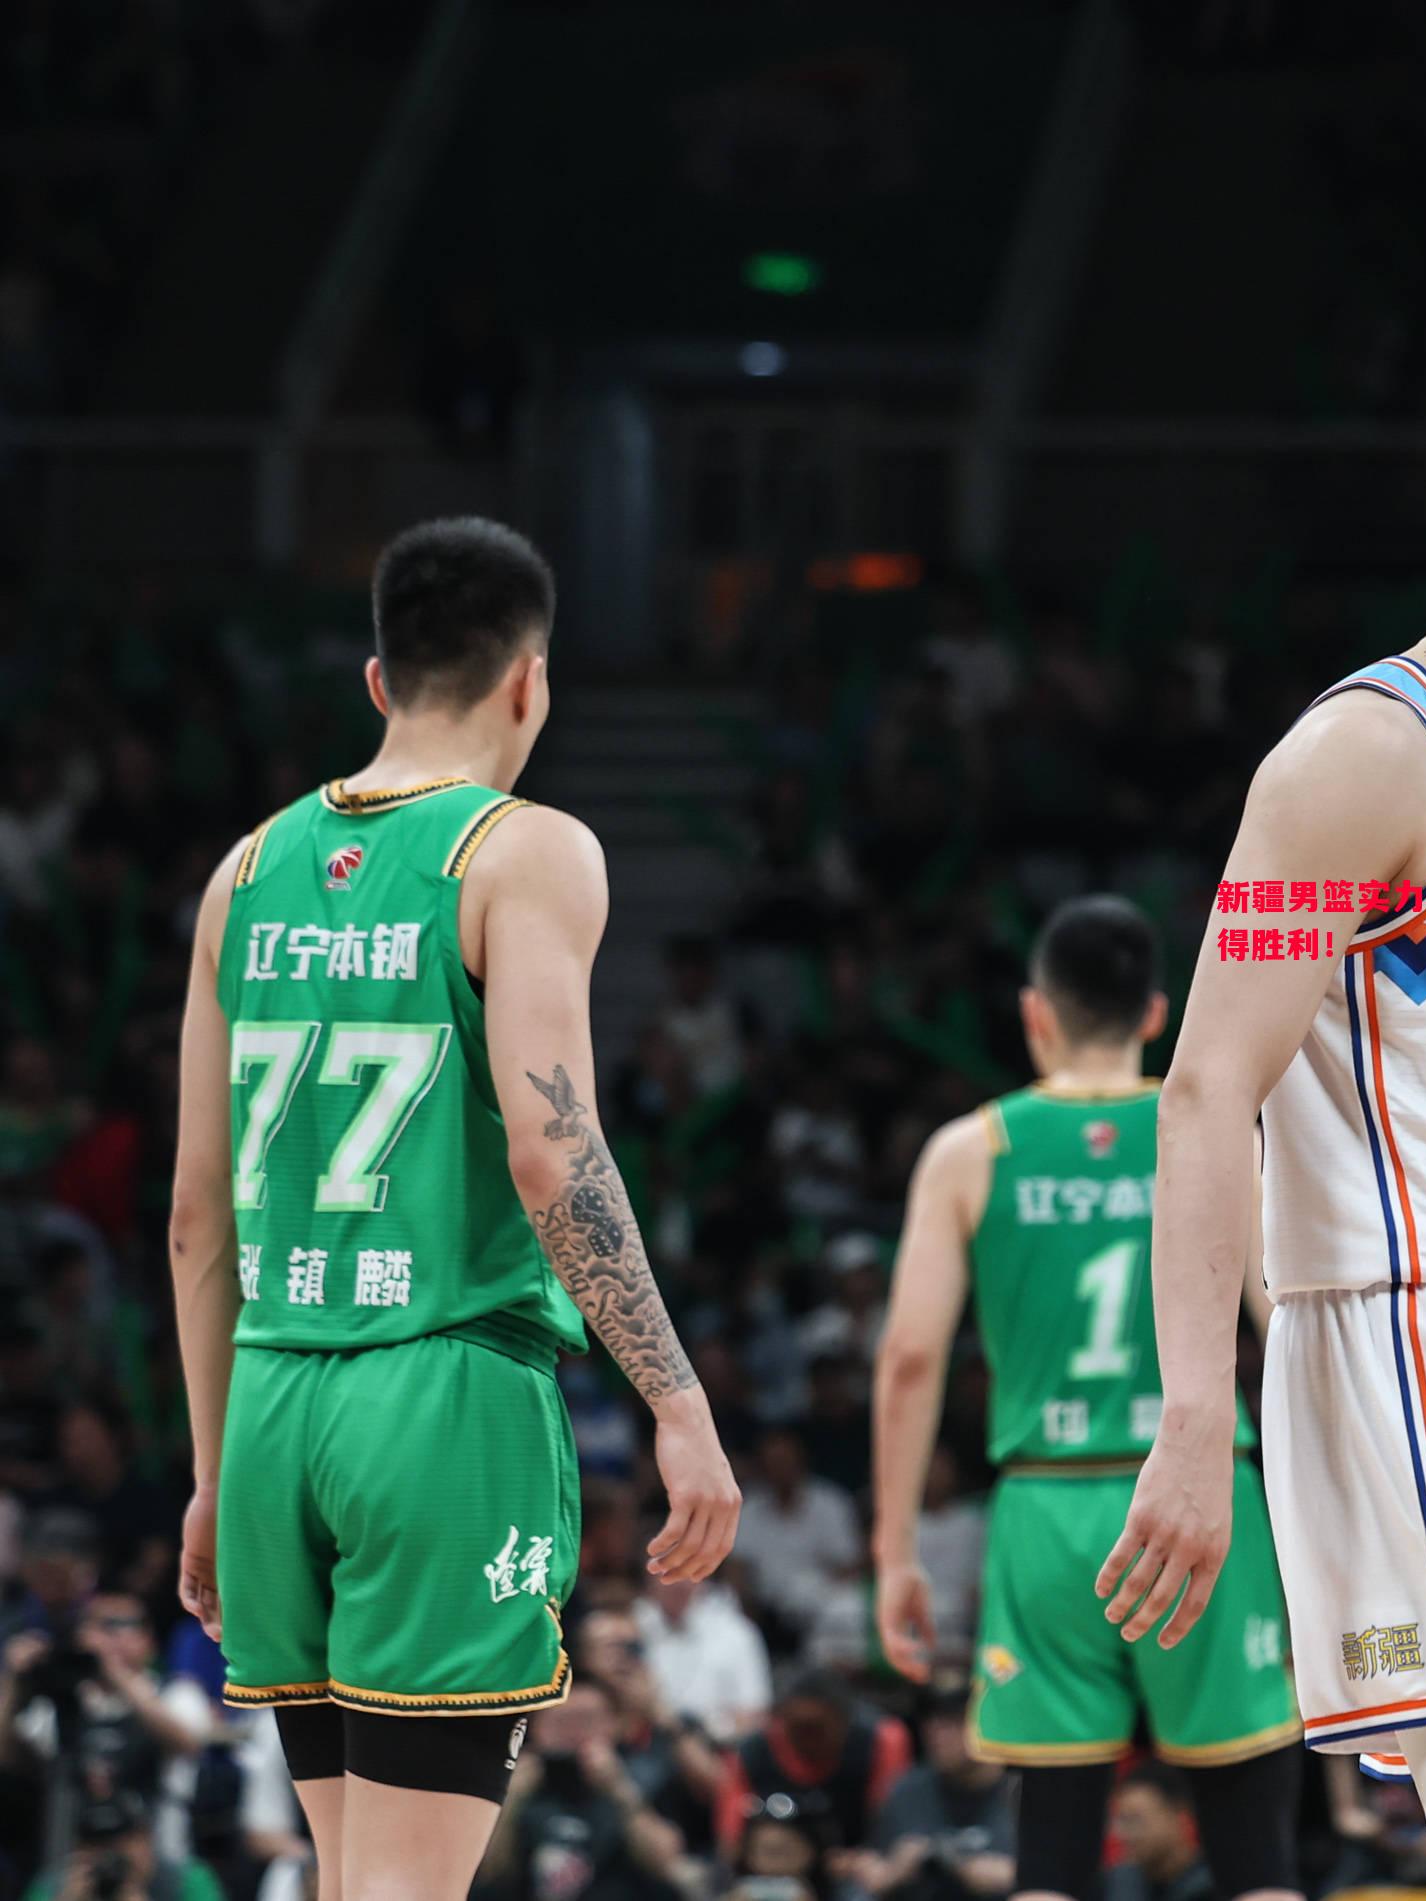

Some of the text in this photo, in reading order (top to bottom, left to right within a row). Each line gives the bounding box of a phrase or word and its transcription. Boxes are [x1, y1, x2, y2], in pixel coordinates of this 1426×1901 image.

[244, 922, 421, 981] 辽宁本钢
[231, 1021, 452, 1213] 77
[1016, 1176, 1157, 1225] 辽宁本
[1068, 1240, 1142, 1380] 1
[1342, 1623, 1425, 1681] 新疆
